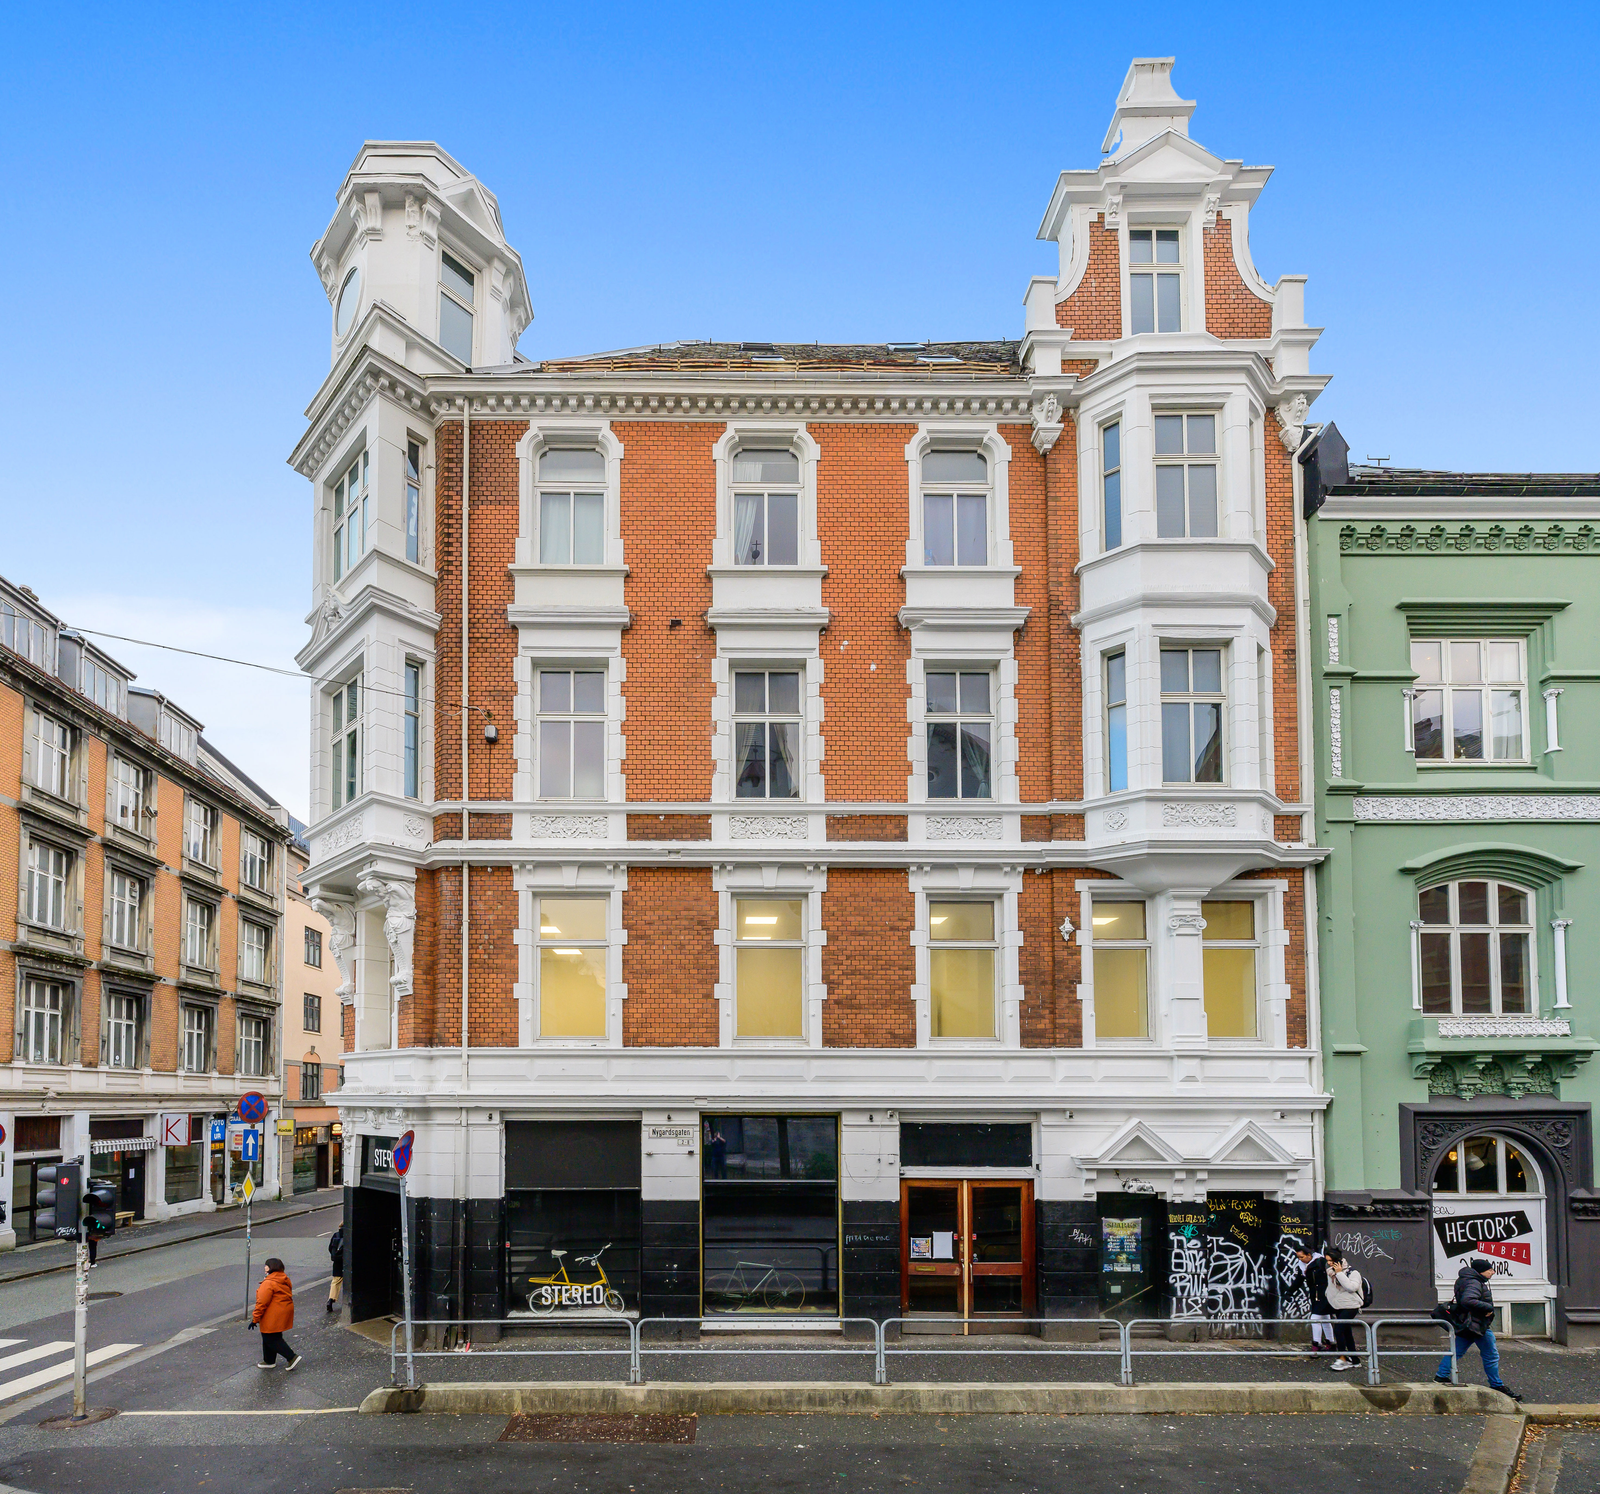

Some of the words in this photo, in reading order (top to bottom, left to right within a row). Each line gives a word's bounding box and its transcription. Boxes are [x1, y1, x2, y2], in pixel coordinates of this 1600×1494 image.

[165, 1118, 181, 1142] K
[1445, 1216, 1518, 1243] HECTOR'S
[1479, 1243, 1527, 1259] HYBEL
[541, 1285, 604, 1305] STEREO
